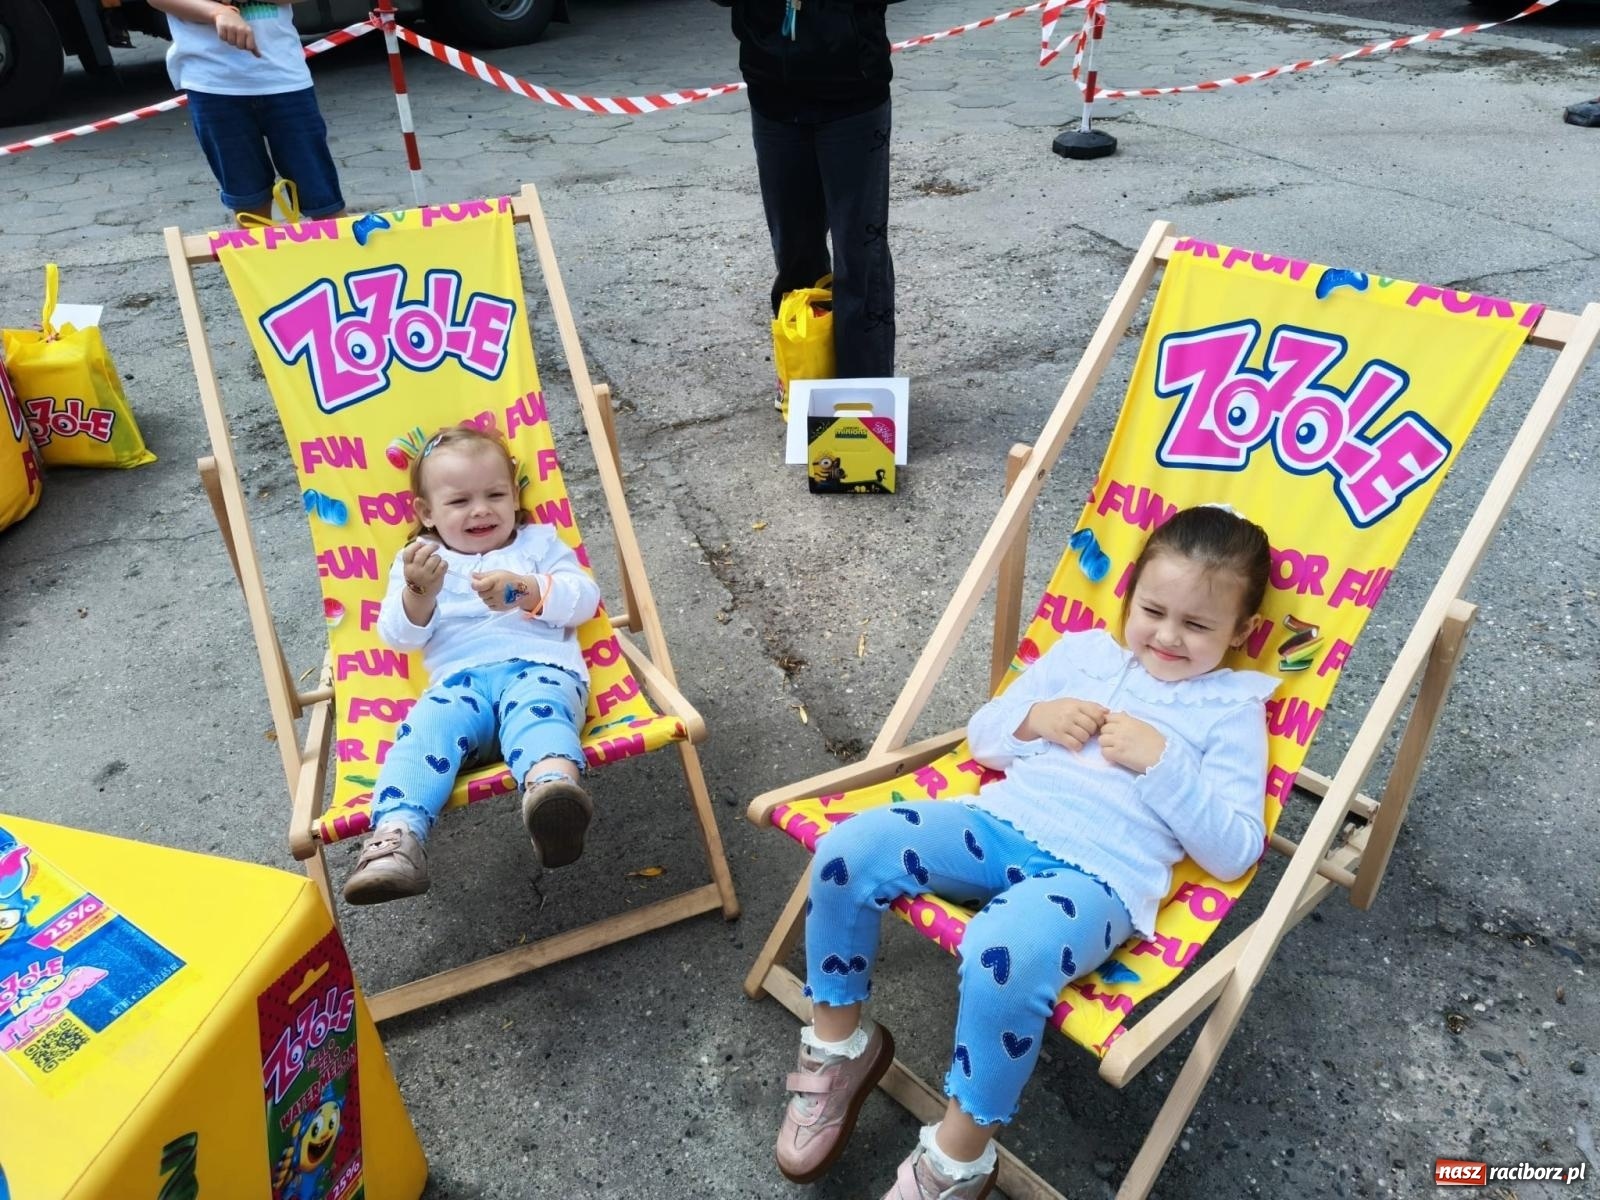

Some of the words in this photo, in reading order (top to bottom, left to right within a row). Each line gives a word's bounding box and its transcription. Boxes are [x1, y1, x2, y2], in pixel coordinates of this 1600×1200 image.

[259, 264, 516, 414] ZOZOLE
[25, 396, 115, 447] OZOLE
[1155, 318, 1453, 529] ZOZOLE
[301, 436, 366, 474] FUN
[1269, 546, 1329, 595] OR
[338, 649, 408, 680] FUN
[596, 674, 640, 717] FU
[44, 902, 97, 940] 25%
[1129, 932, 1203, 969] FU
[0, 955, 64, 1015] OZOLE
[262, 986, 355, 1105] ZOZOLE
[333, 1161, 361, 1198] 25%
